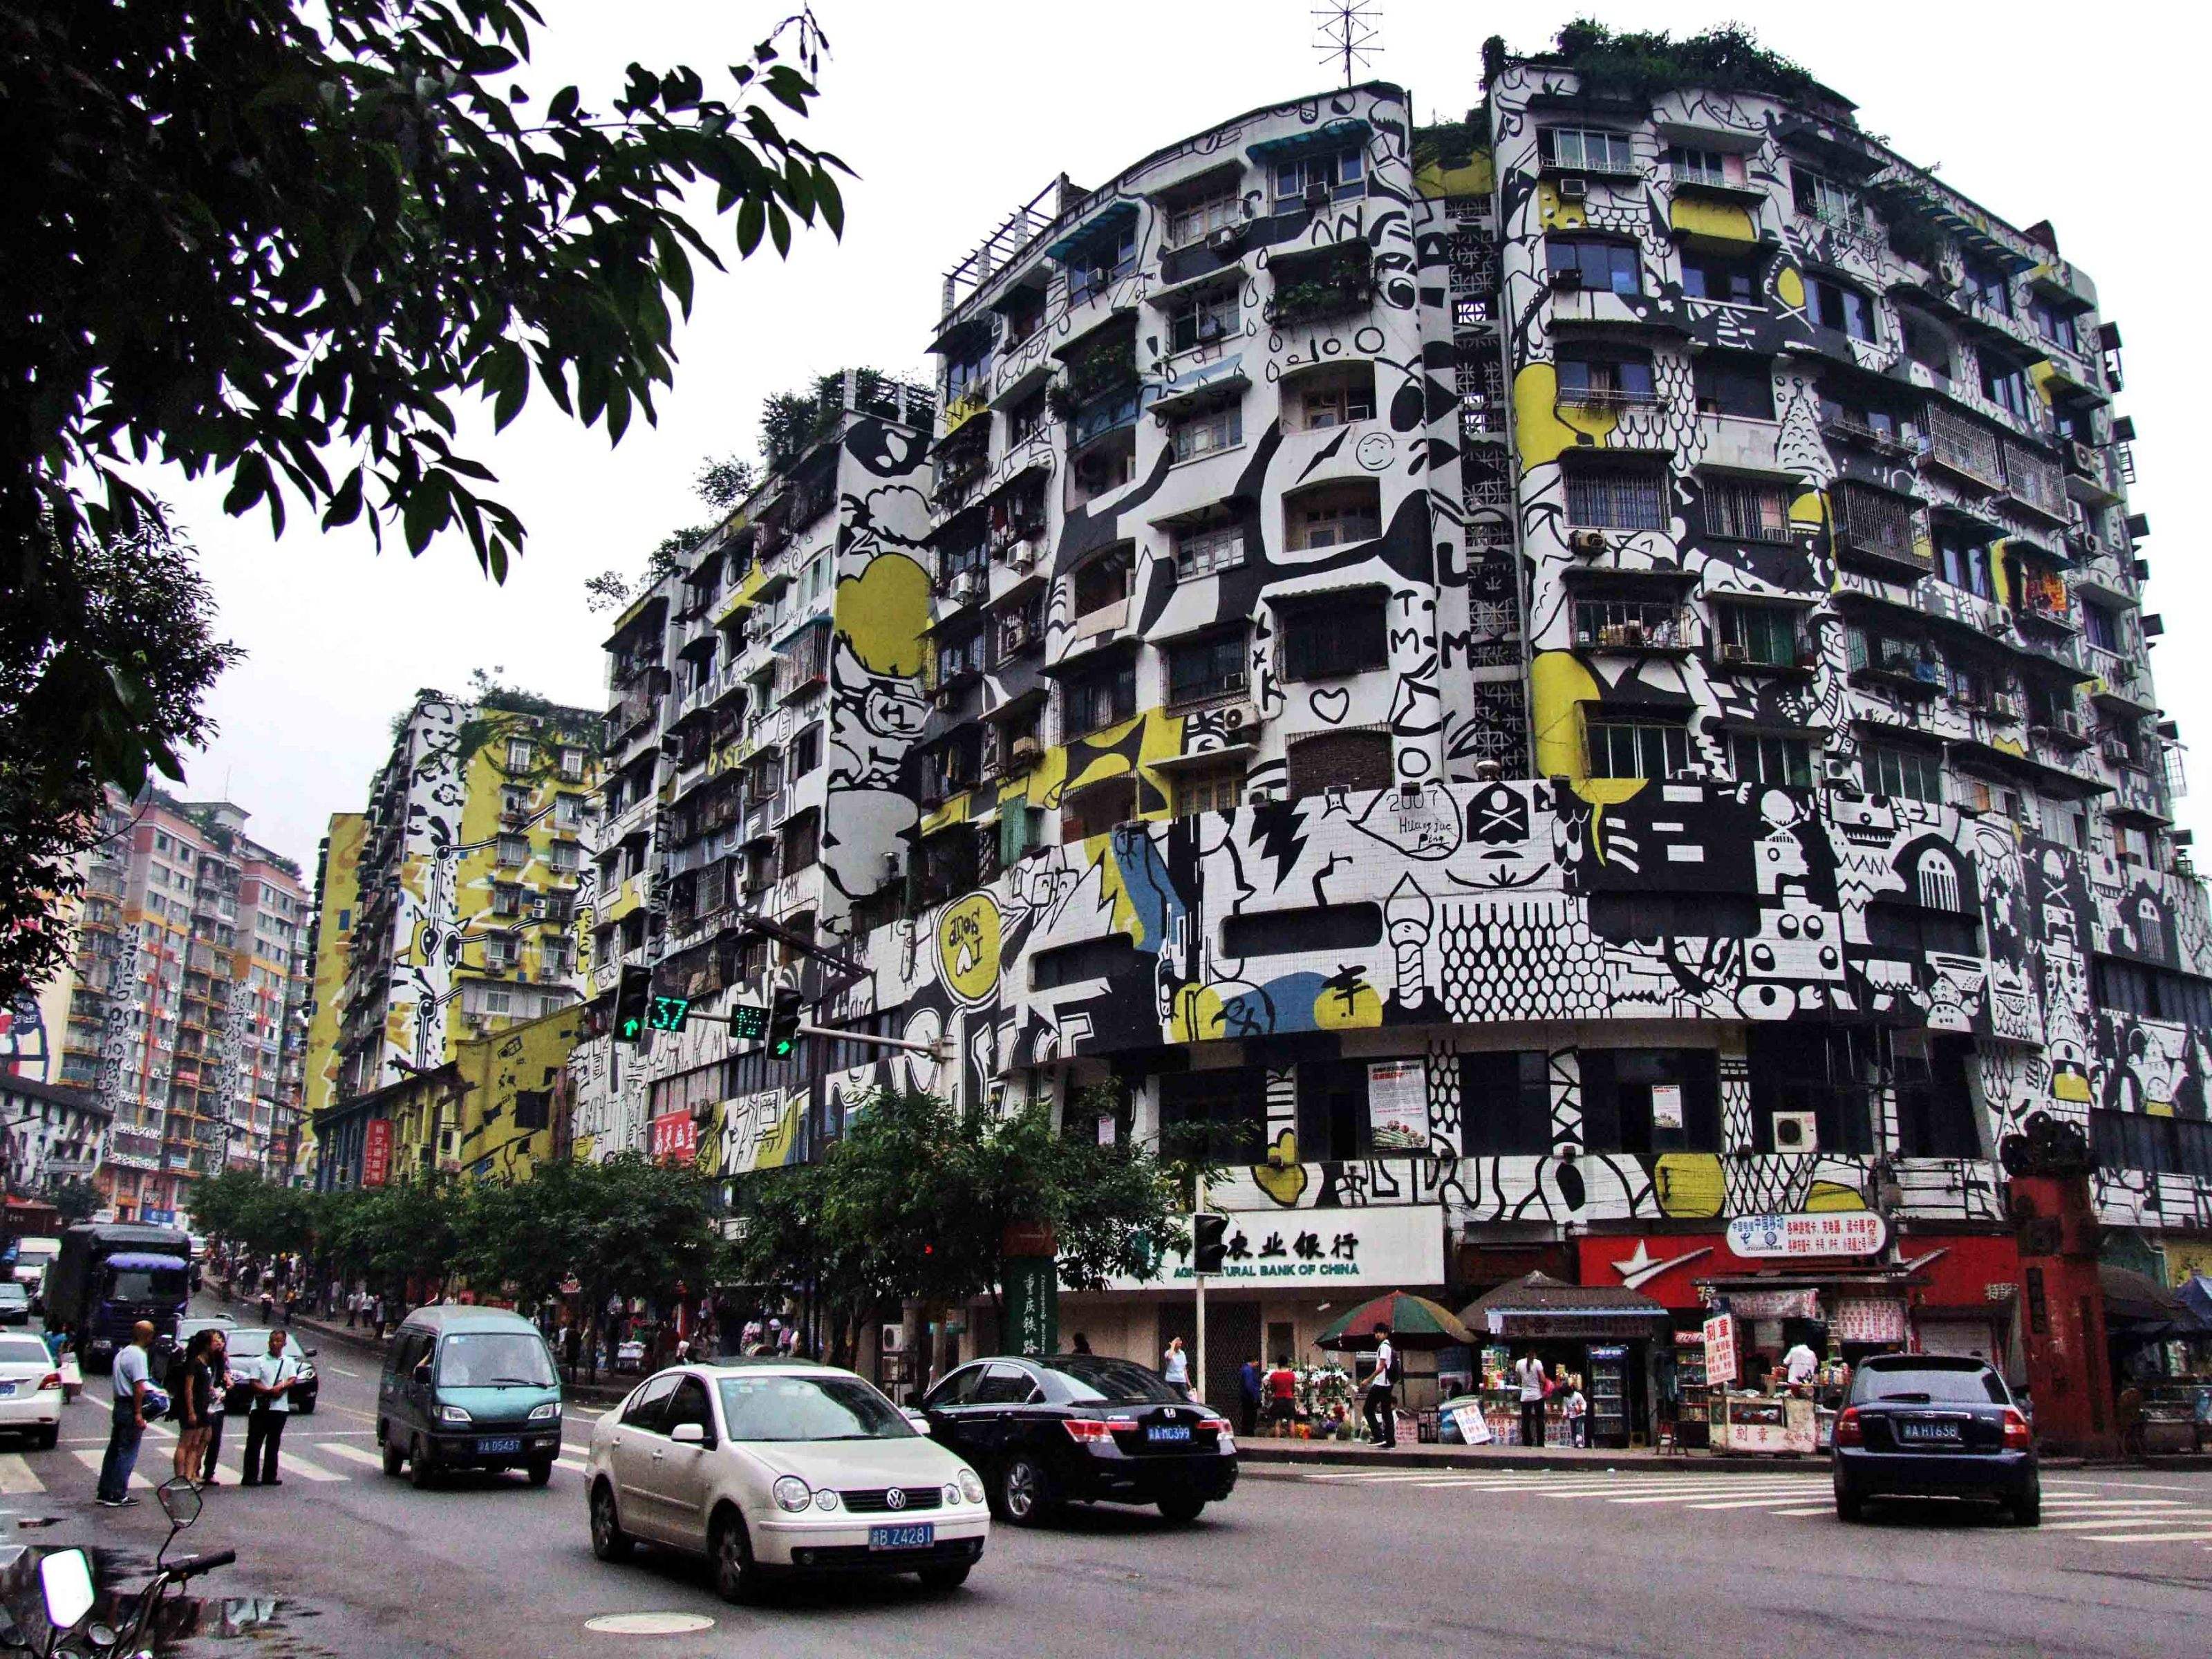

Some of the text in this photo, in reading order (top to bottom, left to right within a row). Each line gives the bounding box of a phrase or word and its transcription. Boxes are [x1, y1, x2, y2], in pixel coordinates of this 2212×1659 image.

[1386, 789, 1438, 812] 2007
[652, 995, 688, 1031] 37
[1179, 1230, 1360, 1264] 农业银行
[1174, 1262, 1360, 1278] AGRTURAL BANK OF CHINA
[892, 1526, 930, 1546] Z4281
